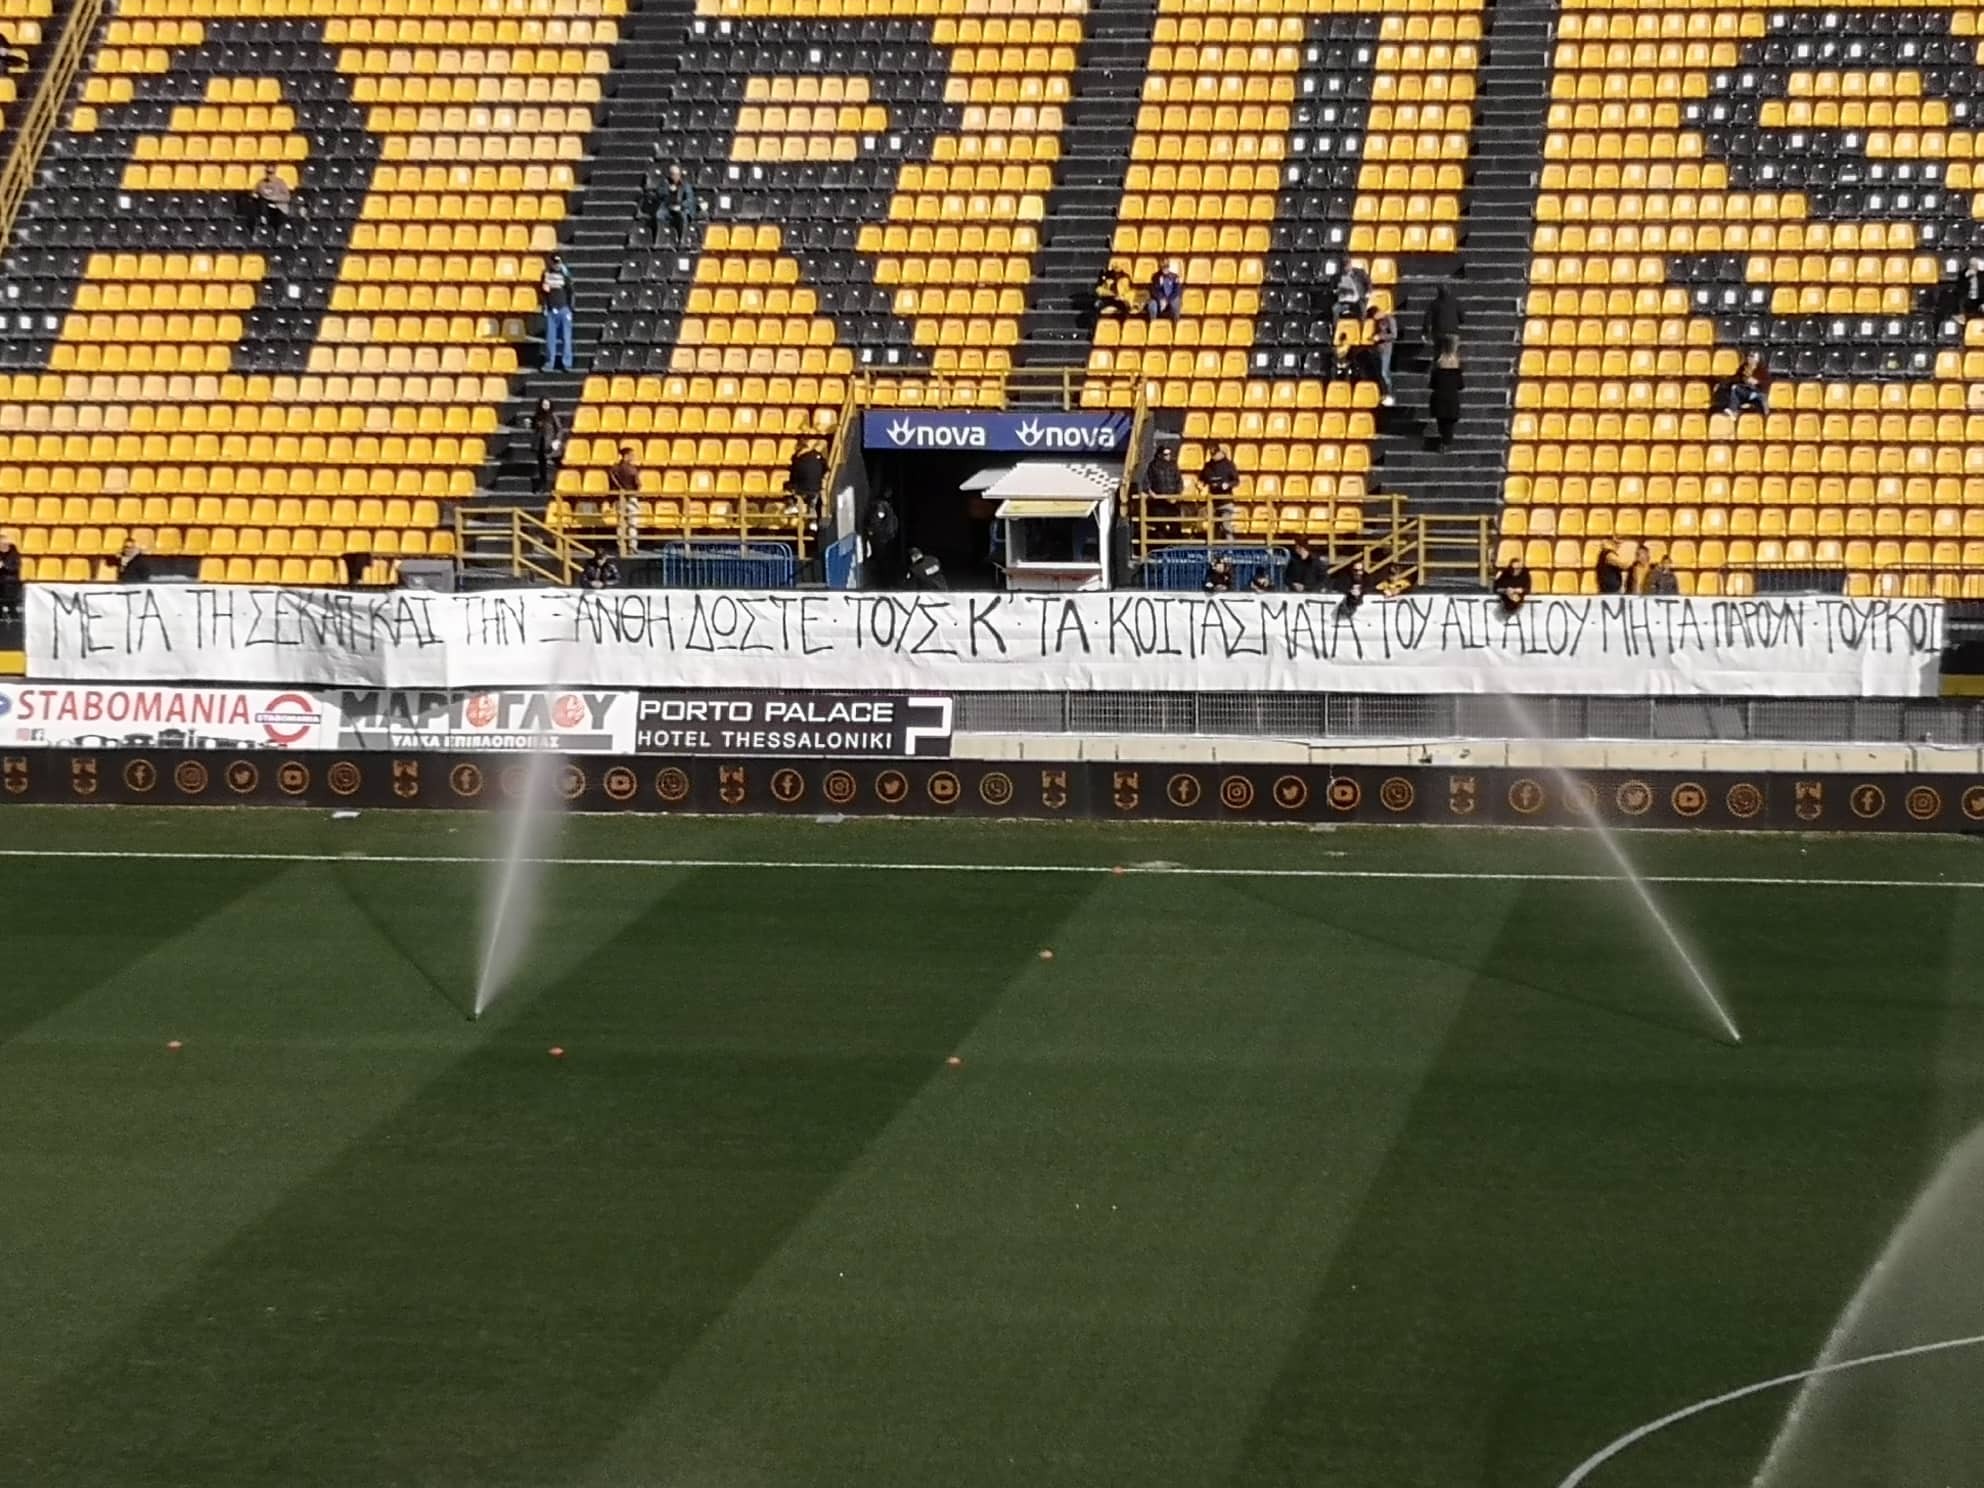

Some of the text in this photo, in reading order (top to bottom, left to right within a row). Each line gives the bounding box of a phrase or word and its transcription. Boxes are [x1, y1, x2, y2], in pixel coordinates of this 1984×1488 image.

[917, 426, 985, 446] nova
[1046, 426, 1114, 447] nova
[50, 588, 171, 659] ΜΕΤΑ
[186, 588, 235, 649] ΤΗ
[368, 596, 444, 650] ΚΑΙ
[452, 596, 526, 645] ΤΗΝ
[540, 594, 674, 650] ΞΑΝΘΗ
[844, 595, 957, 653] ΤΟΥΣ
[1026, 596, 1090, 656] ΤΑ
[1109, 597, 1363, 660] ΚΟΙΤΑΣΜΑΤΑ
[1371, 597, 1433, 658] ΤΟΥ
[1601, 597, 1655, 657] ΜΗ
[1656, 598, 1704, 654] ΤΑ
[1816, 599, 1945, 655] ΤΟΥΡΚΟΙ
[17, 689, 250, 724] STABOMANIA
[640, 700, 894, 723] PORTO PALACE
[637, 730, 892, 749] HOTEL THESSALONIKI
